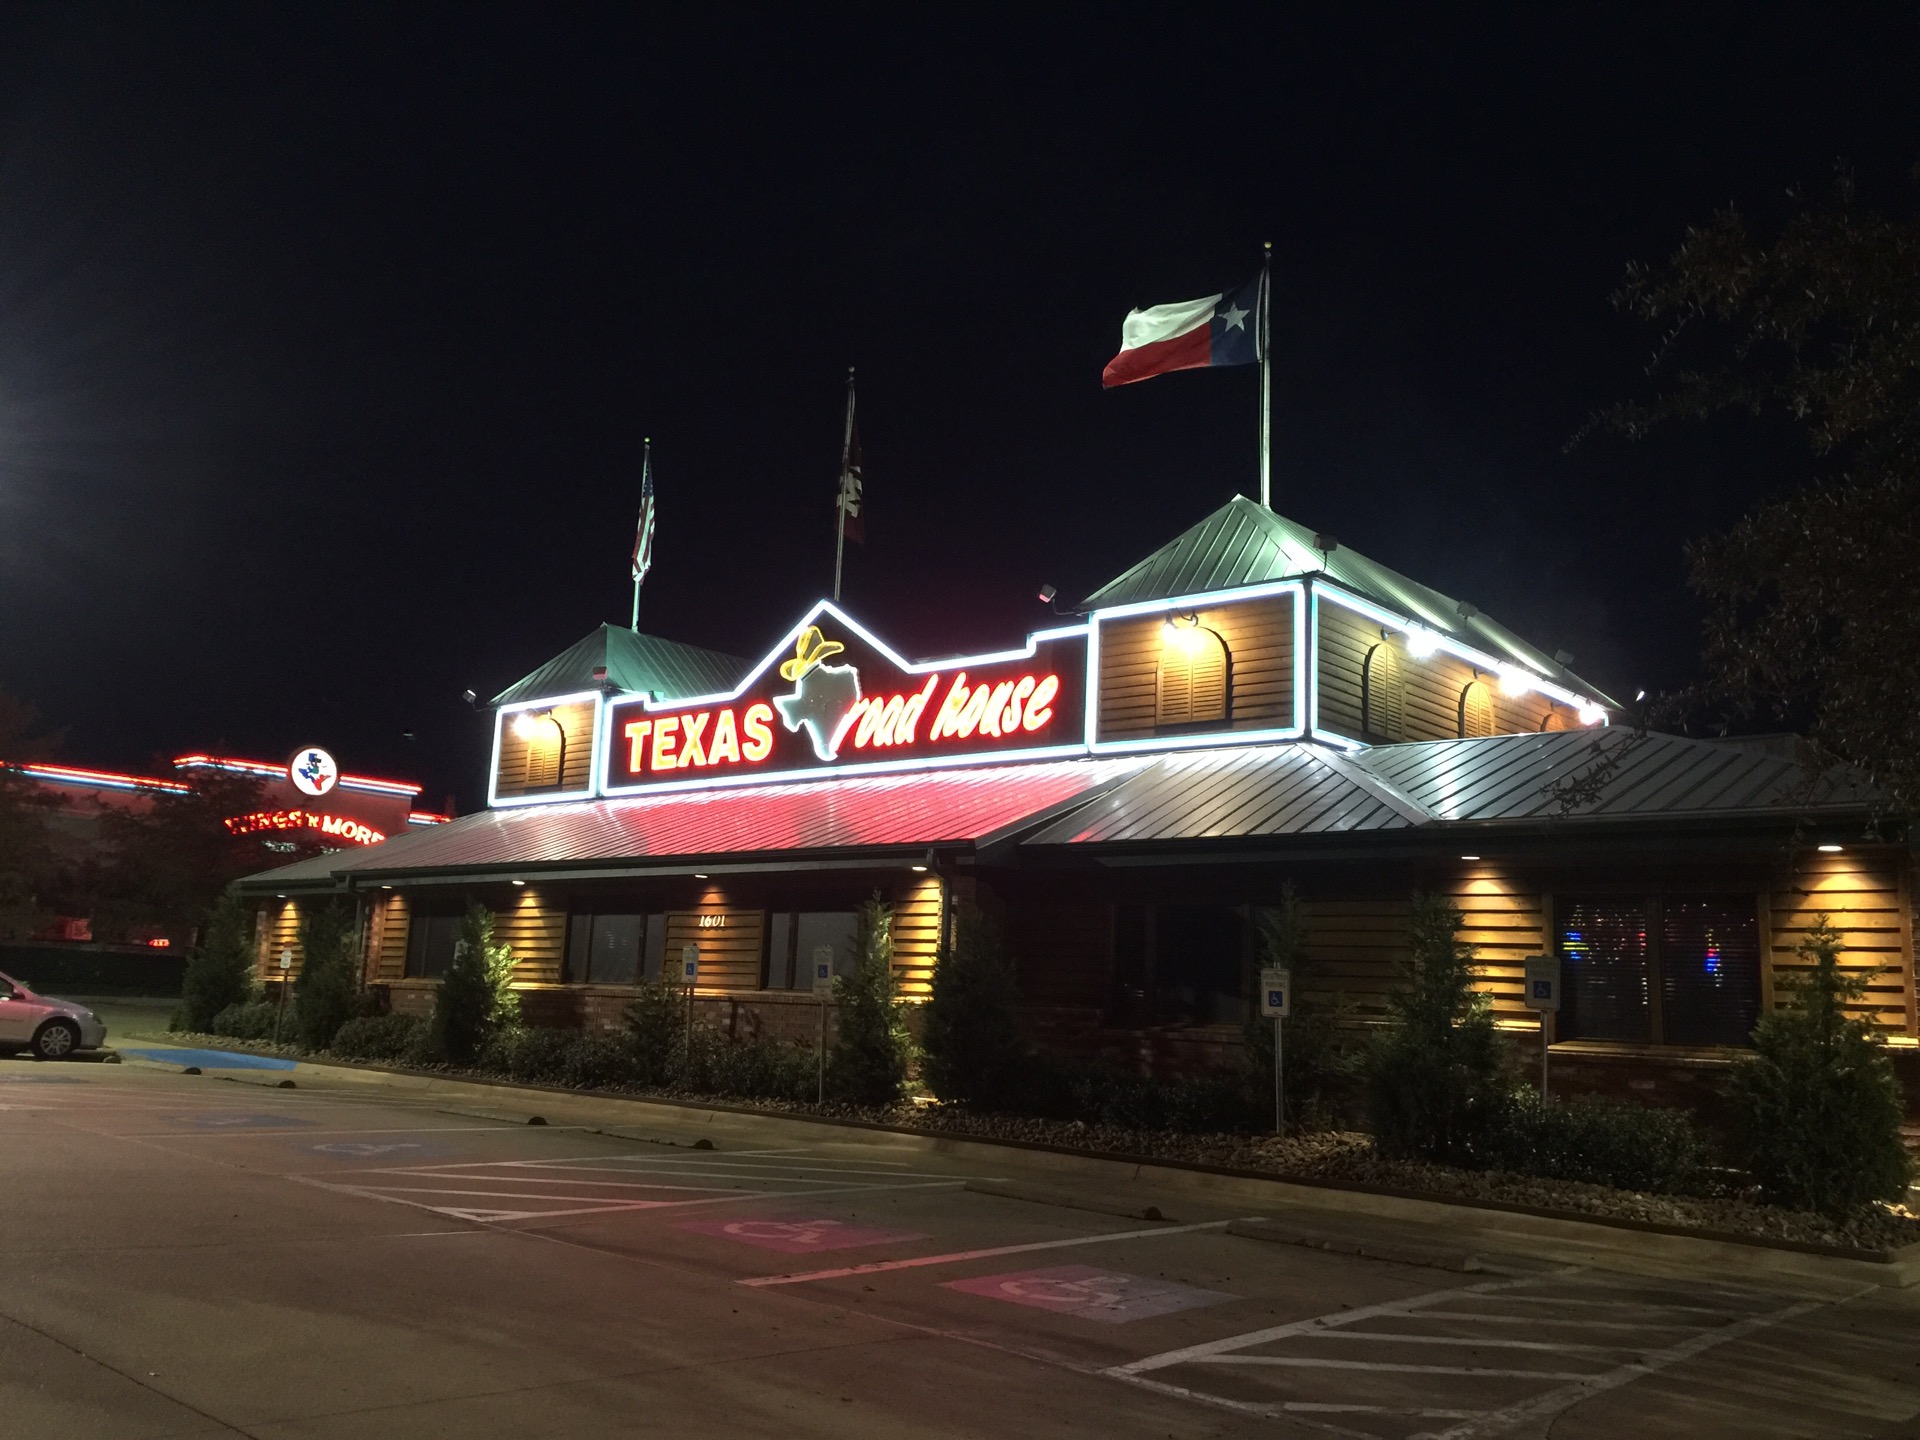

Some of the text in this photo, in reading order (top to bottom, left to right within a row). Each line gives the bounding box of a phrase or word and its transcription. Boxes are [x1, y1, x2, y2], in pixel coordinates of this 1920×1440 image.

[624, 671, 1059, 773] TEXAS road house
[698, 915, 726, 928] 1601
